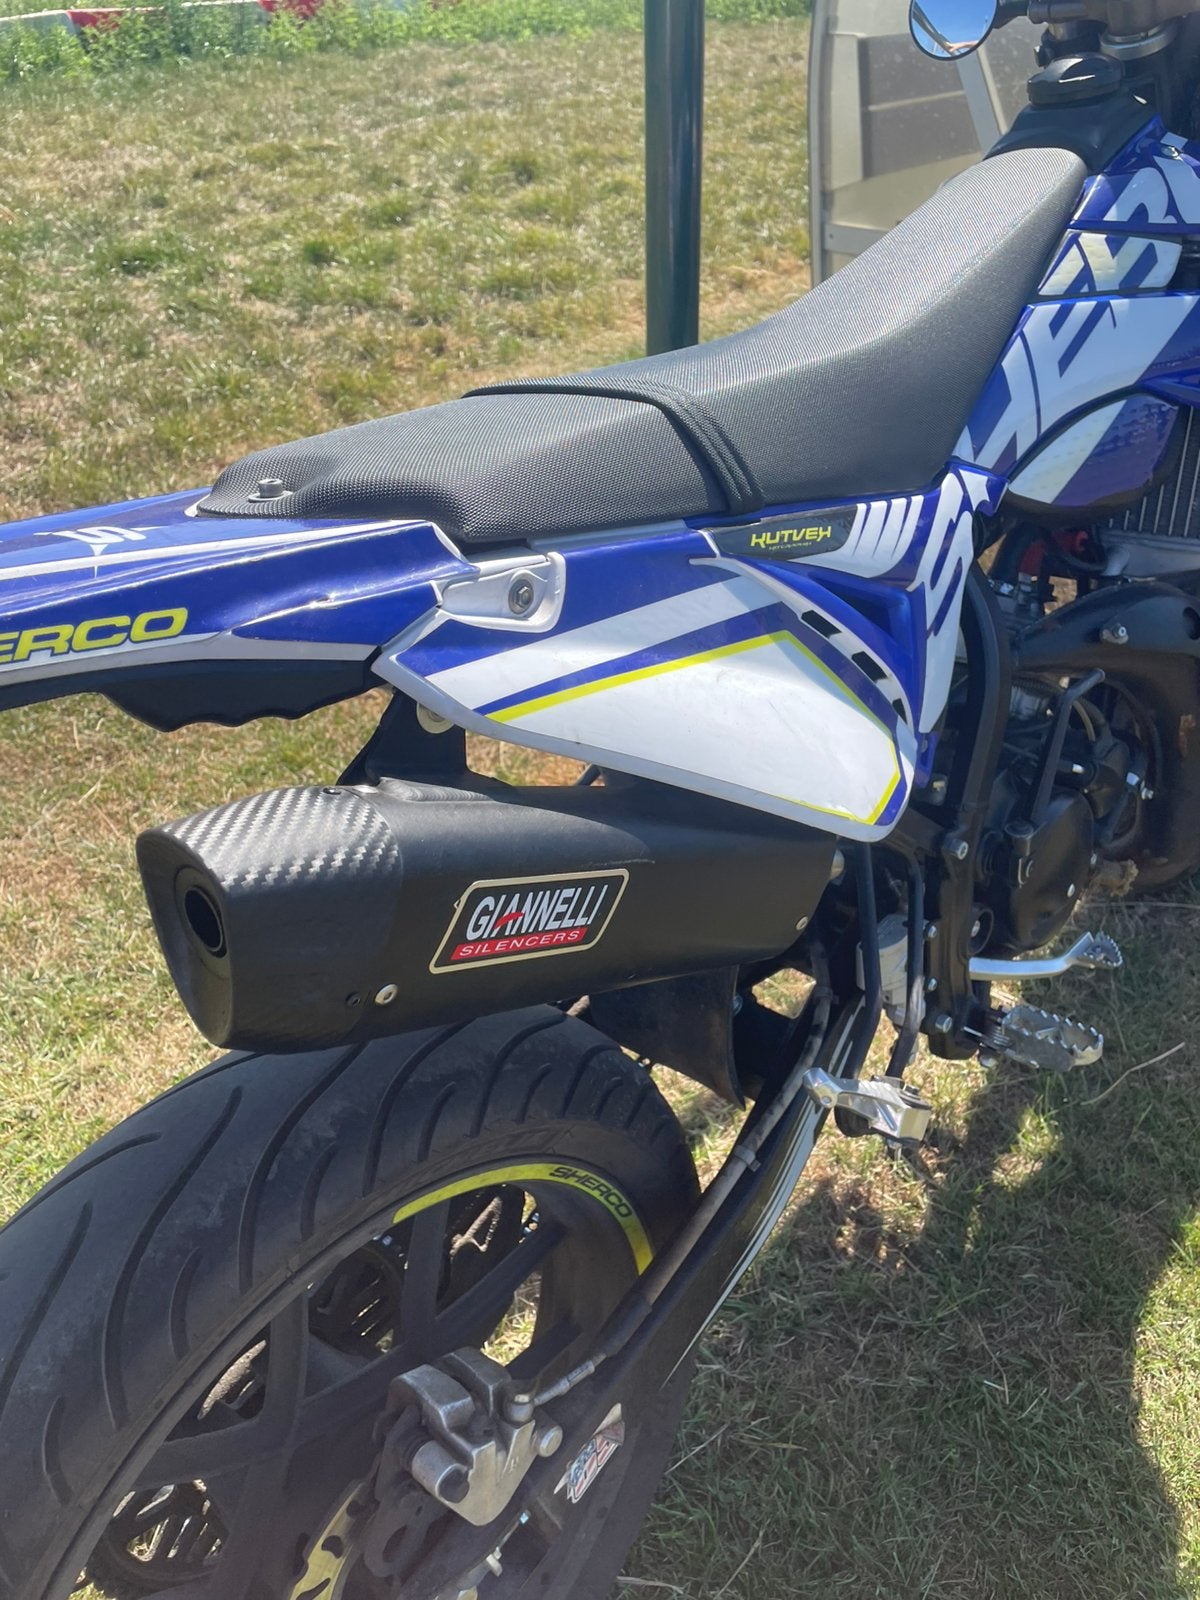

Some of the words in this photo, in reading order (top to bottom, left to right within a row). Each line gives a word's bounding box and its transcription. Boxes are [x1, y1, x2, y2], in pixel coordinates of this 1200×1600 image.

[465, 884, 609, 941] GIANNELLI
[459, 930, 580, 957] SILENCERS
[549, 1166, 633, 1218] SHERCO
